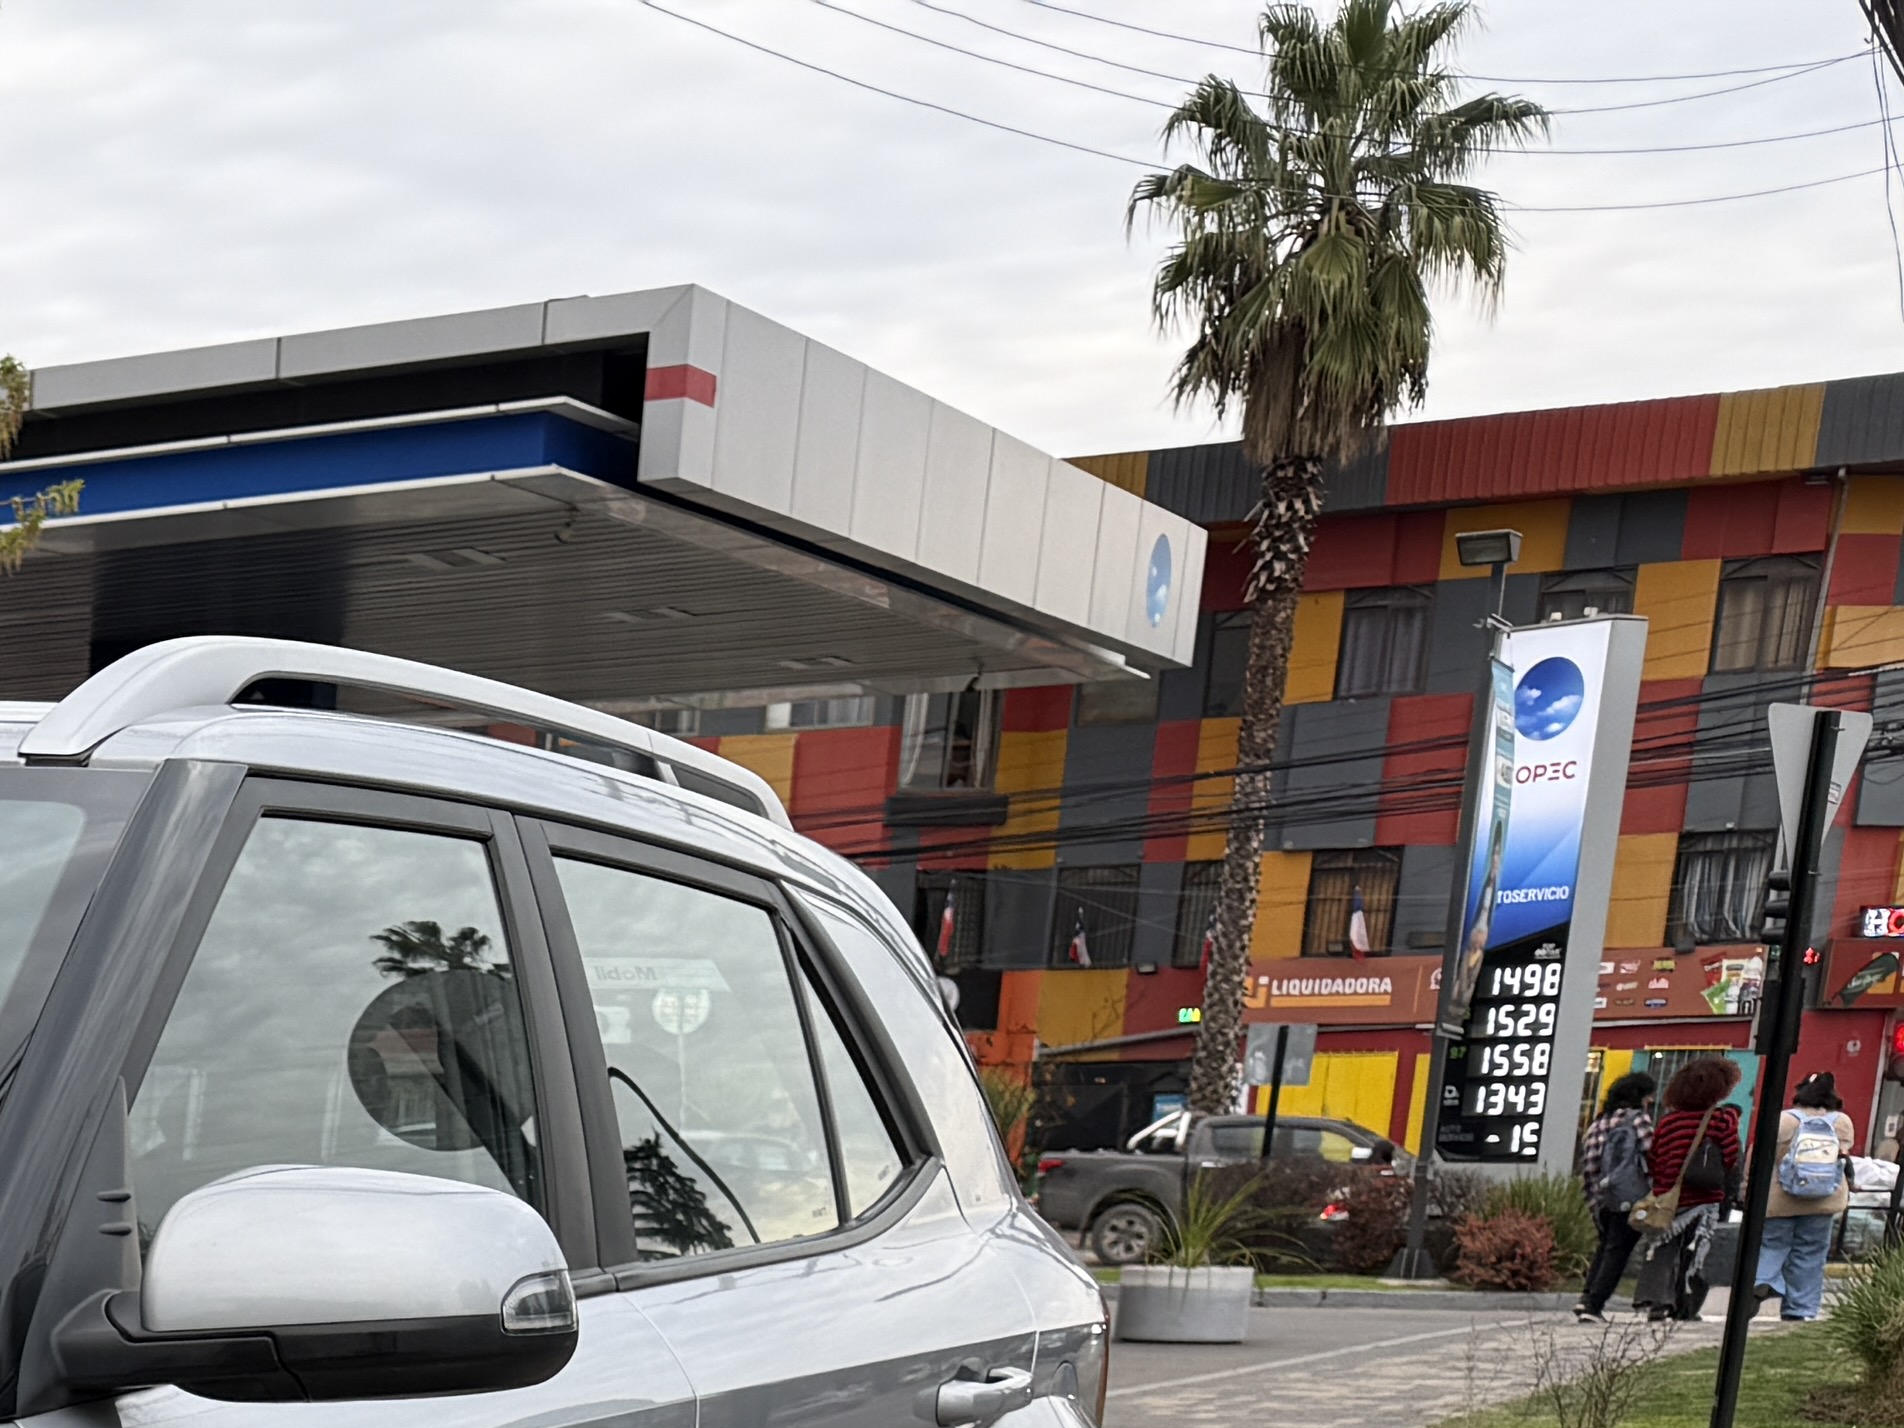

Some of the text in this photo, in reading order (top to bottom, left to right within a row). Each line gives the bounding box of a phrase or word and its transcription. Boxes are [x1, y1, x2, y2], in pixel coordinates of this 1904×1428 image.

[1514, 760, 1579, 785] OPEC
[1497, 885, 1570, 904] TOSERVICIO
[1271, 976, 1392, 996] LIQUIDADORA
[1492, 962, 1562, 998] 1498
[1486, 1002, 1556, 1037] 1529
[1481, 1042, 1551, 1077] 1558
[1475, 1082, 1546, 1116] 1343
